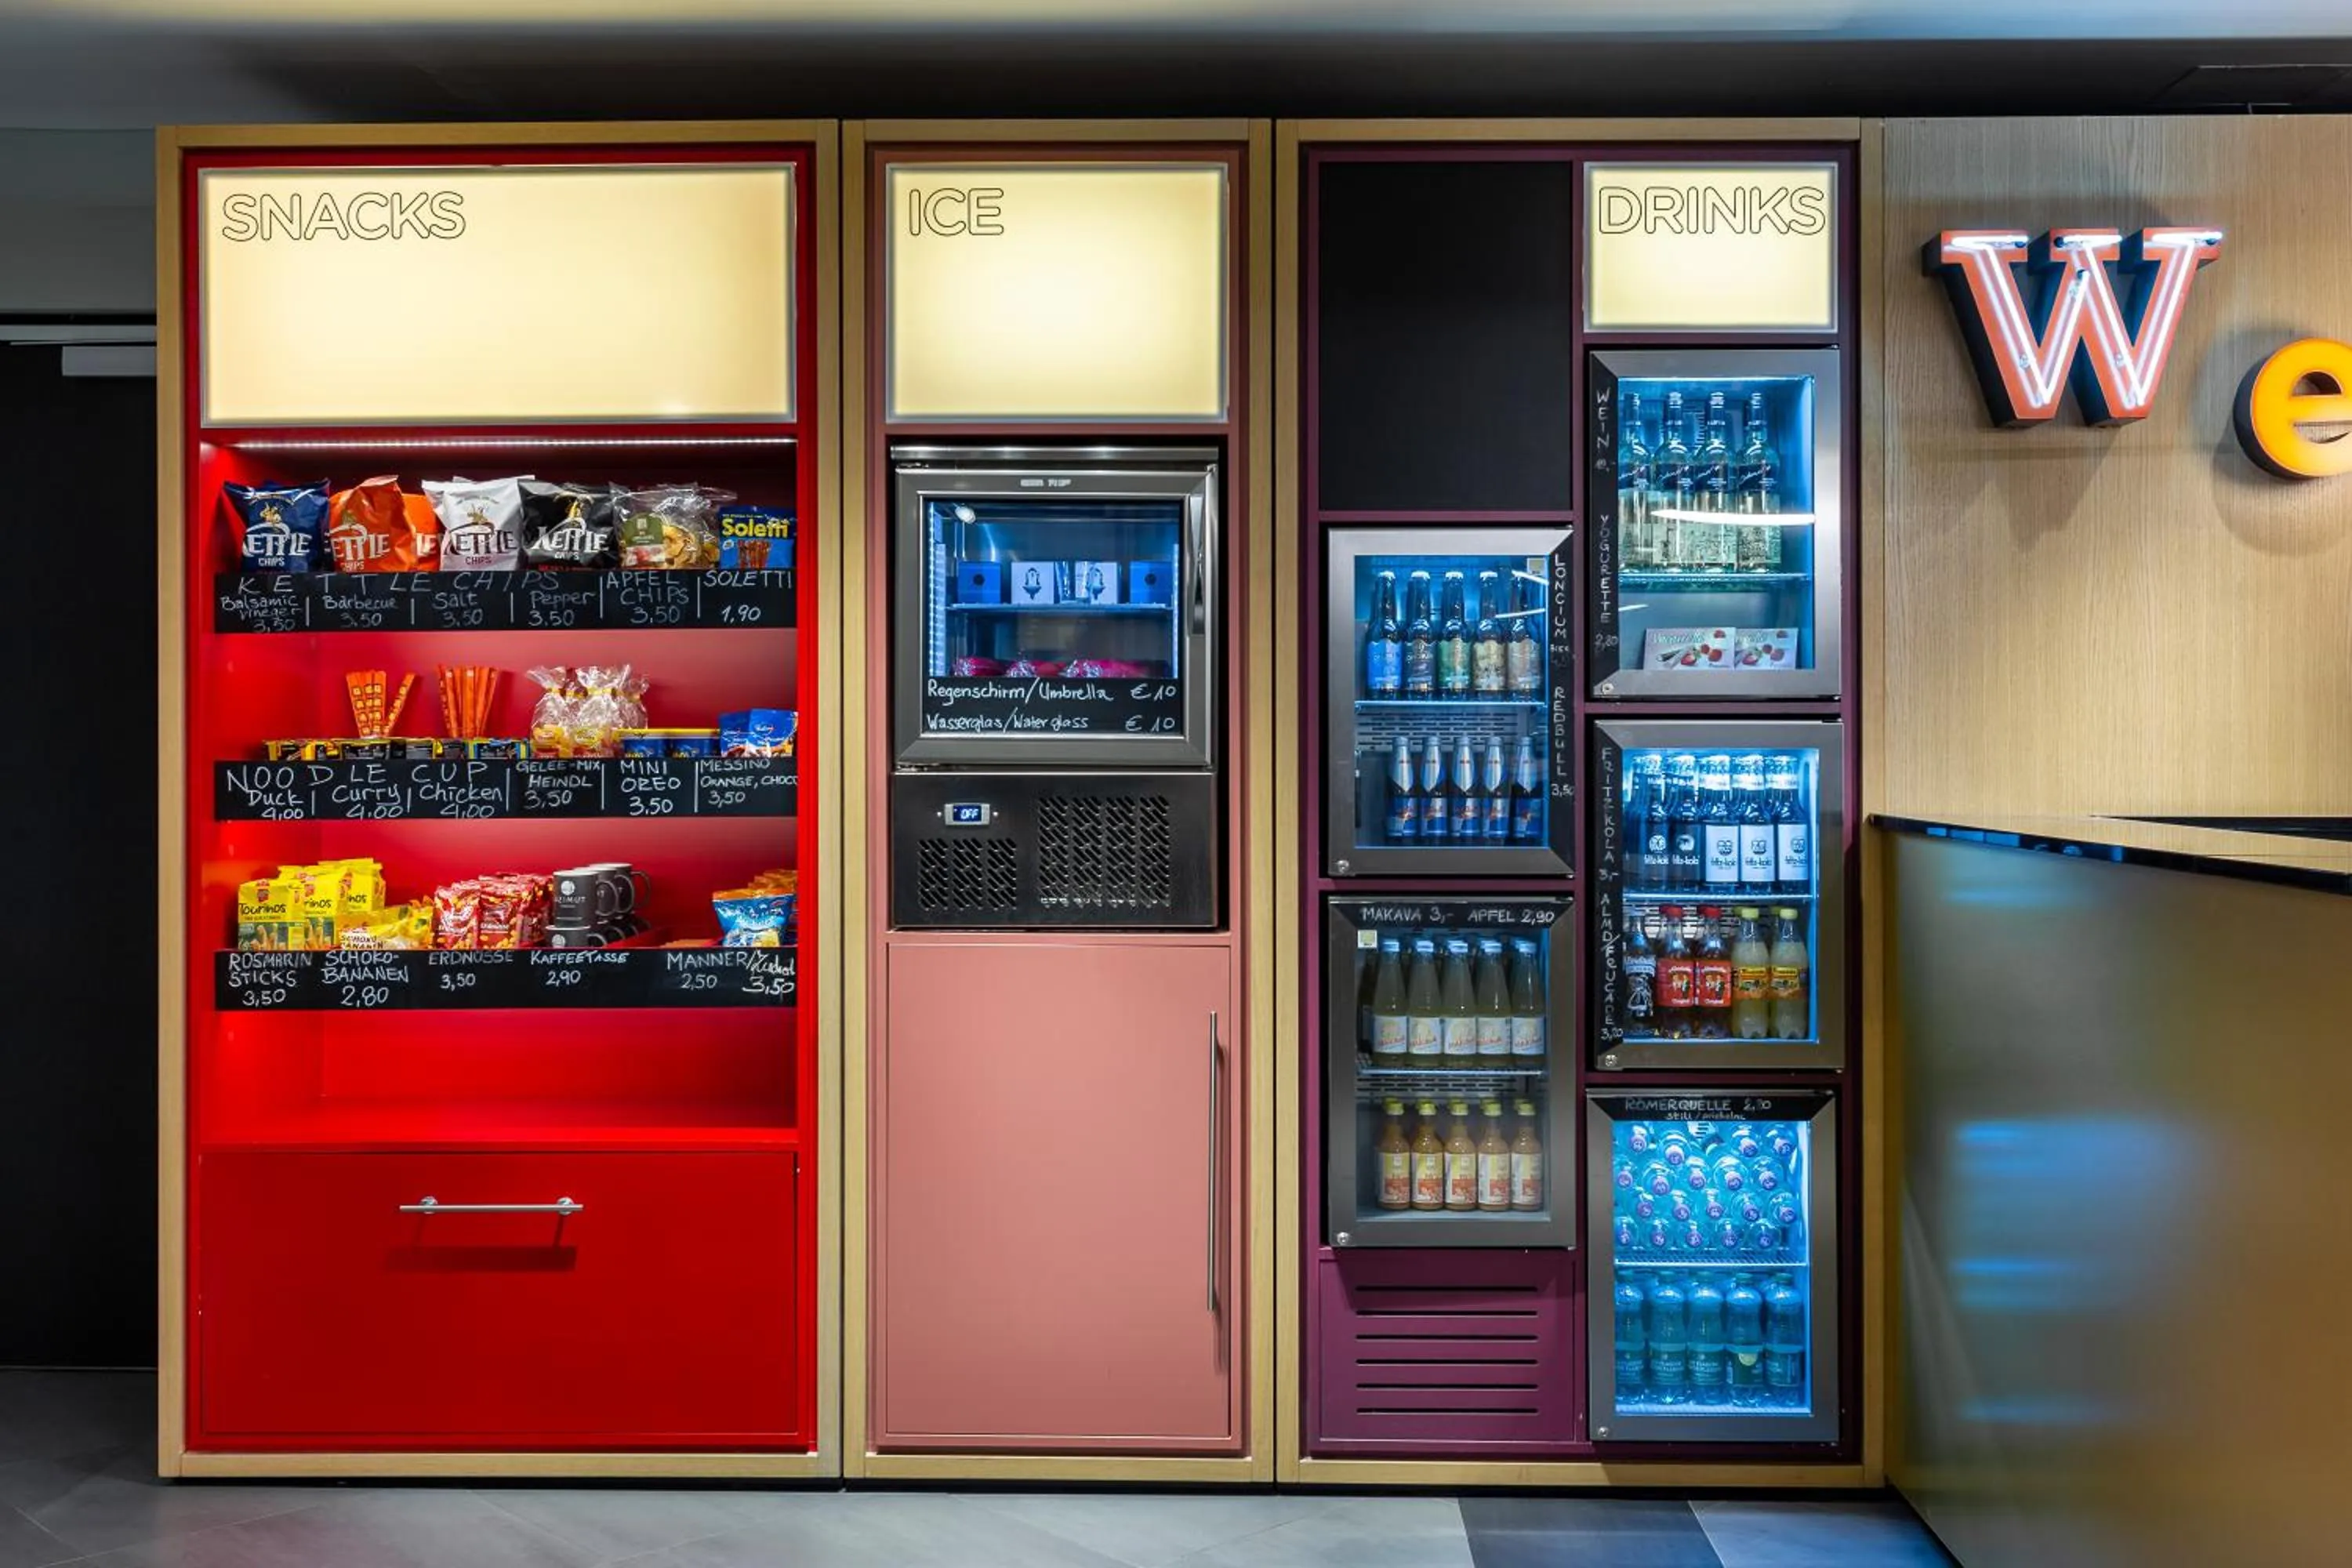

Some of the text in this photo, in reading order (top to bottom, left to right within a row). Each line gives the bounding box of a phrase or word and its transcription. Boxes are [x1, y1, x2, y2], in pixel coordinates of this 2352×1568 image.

[222, 191, 466, 242] SNACKS
[908, 187, 1004, 237] ICE
[1598, 185, 1827, 235] DRINKS
[1596, 387, 1610, 449] WEIN
[329, 524, 390, 561] ETTLE
[532, 519, 609, 554] KETTLE
[259, 557, 285, 567] CHIPS
[466, 556, 492, 564] CHIPS
[607, 572, 680, 588] APFEL
[704, 571, 792, 588] SOLETTI
[220, 595, 299, 612] Balsamic
[323, 596, 398, 611] Barbecue
[434, 592, 477, 610] Salt
[531, 591, 596, 610] Pepper
[621, 588, 690, 604] CHIPS
[1554, 553, 1566, 638] LONCIUM
[1151, 717, 1175, 732] 10
[412, 762, 488, 783] CUP
[621, 760, 667, 775] MINI
[700, 759, 771, 773] MESSINO
[528, 775, 593, 788] HEINDL
[248, 789, 304, 806] Duck
[332, 784, 401, 805] Curry
[419, 785, 503, 802] Chicken
[960, 808, 979, 820] OFF
[1359, 907, 1421, 921] MAKAVA
[1468, 909, 1515, 922] APFEL
[229, 952, 312, 971] ROSMARIN
[531, 950, 630, 964] KAFFEETASSE
[229, 971, 296, 988] STICKS
[321, 967, 408, 982] BANANEN
